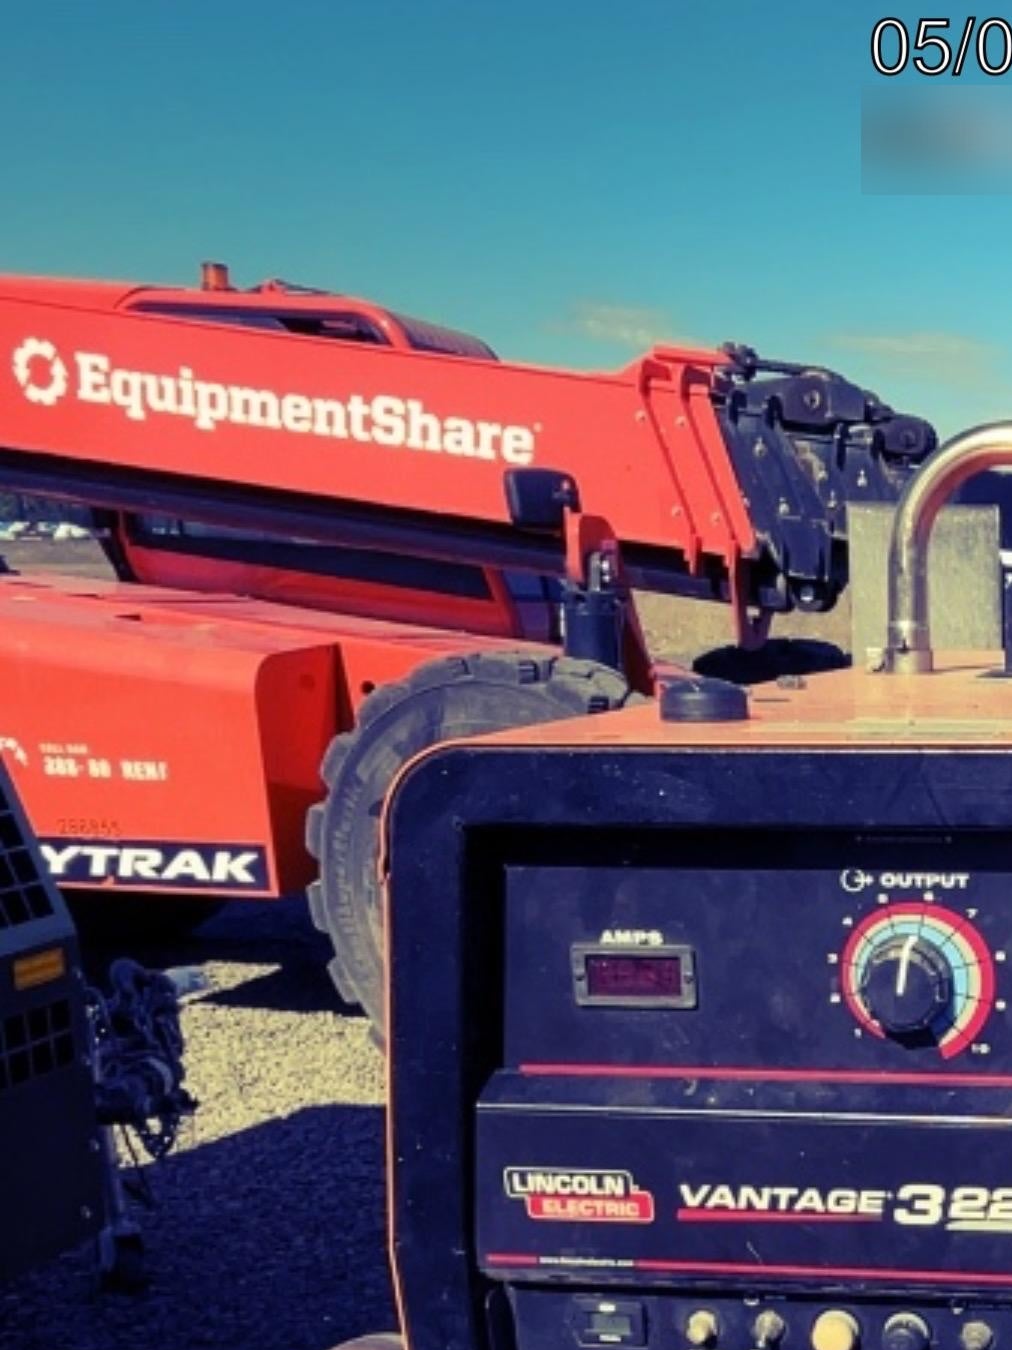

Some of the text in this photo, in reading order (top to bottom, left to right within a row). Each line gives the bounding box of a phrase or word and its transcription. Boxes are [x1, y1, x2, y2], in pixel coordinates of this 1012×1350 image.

[74, 352, 538, 464] EquipmentShare
[879, 872, 970, 889] OUTPUT
[600, 928, 664, 945] AMPS
[511, 1172, 626, 1196] LINCOLN
[541, 1199, 640, 1217] ELECTRIC
[678, 1183, 887, 1214] VANTAGE
